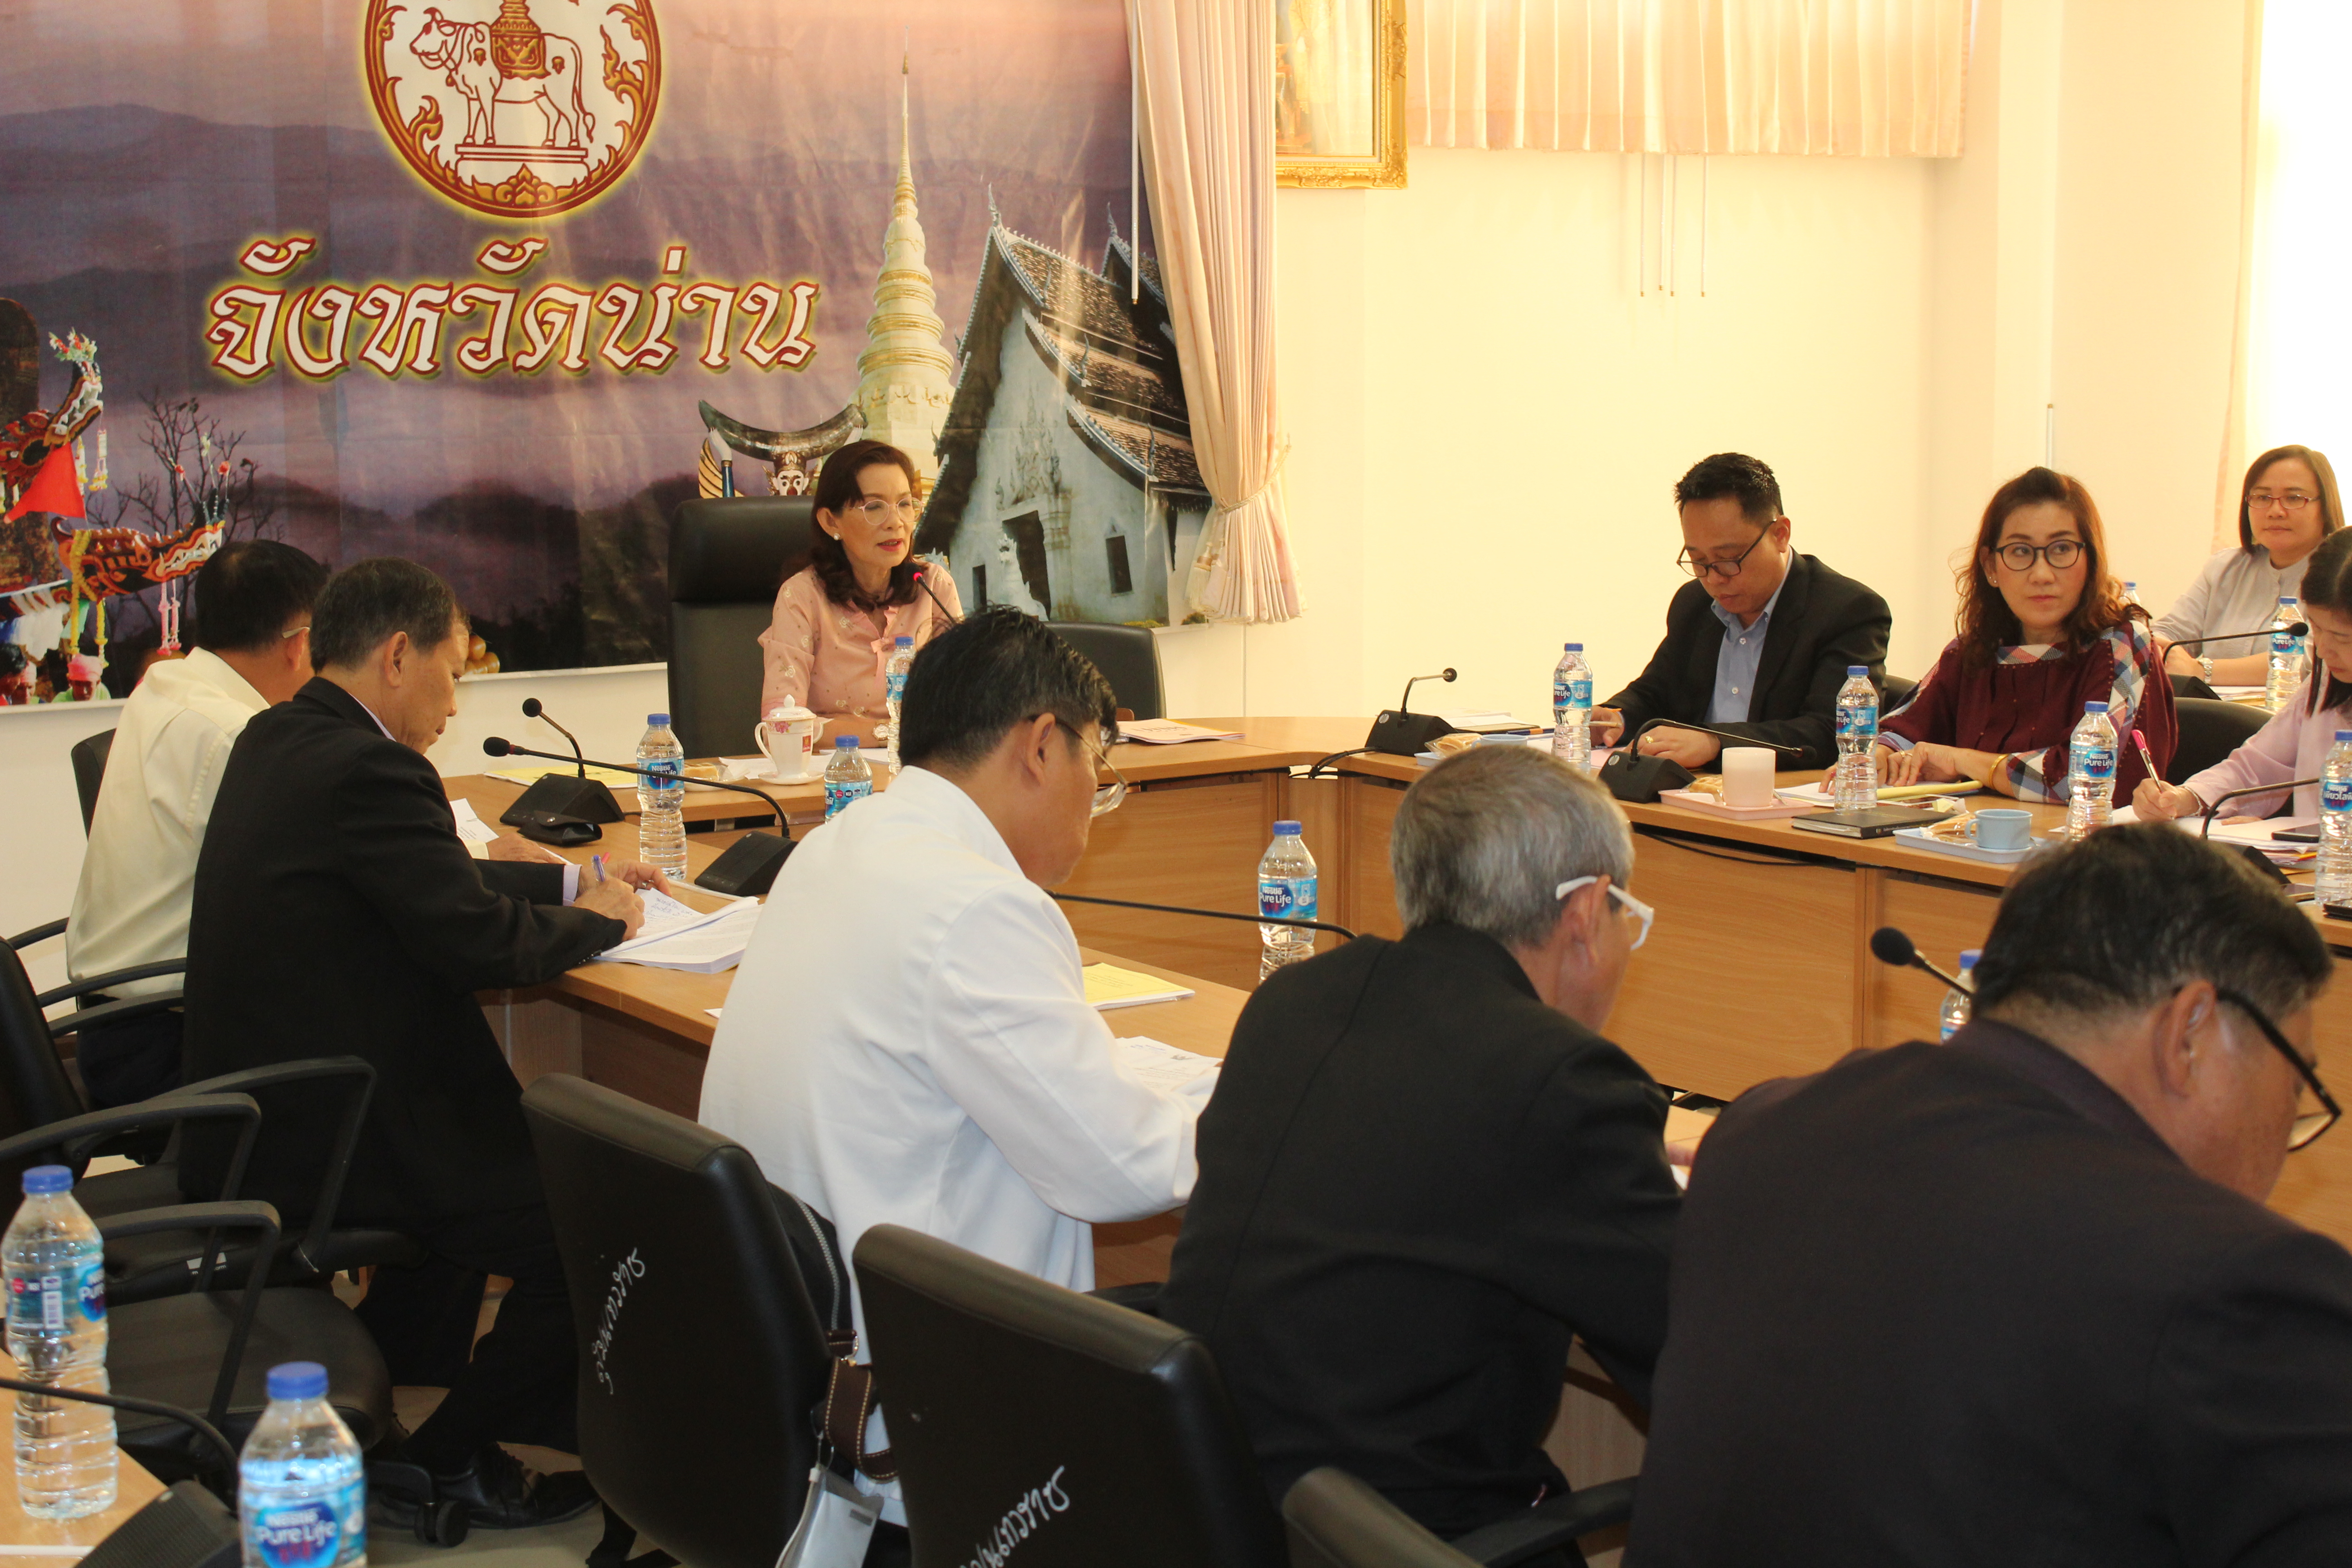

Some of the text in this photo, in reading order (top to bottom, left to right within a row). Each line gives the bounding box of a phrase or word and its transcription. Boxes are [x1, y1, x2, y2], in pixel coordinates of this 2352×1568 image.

[206, 237, 819, 378] จังหวัดน่าน
[1561, 690, 1571, 699] Life
[1840, 716, 1851, 725] Life
[2084, 758, 2114, 769] Pure Life
[1259, 892, 1292, 907] Pure Life
